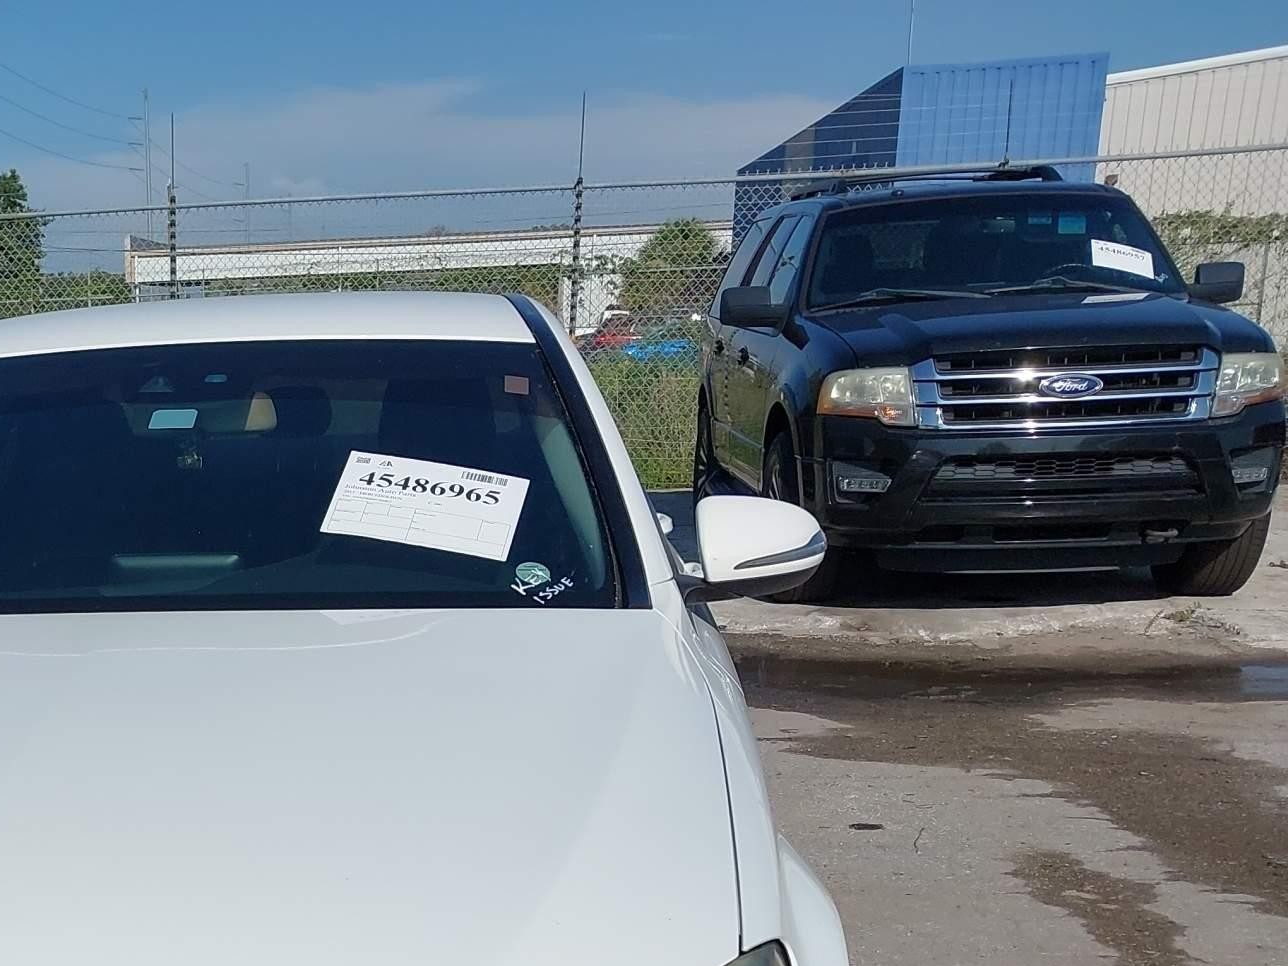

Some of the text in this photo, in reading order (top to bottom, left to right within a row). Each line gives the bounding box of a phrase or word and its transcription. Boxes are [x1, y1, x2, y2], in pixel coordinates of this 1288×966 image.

[1053, 379, 1088, 392] Ford
[359, 472, 501, 505] 45486965
[511, 568, 551, 595] KEY
[533, 577, 573, 604] ISSUE
